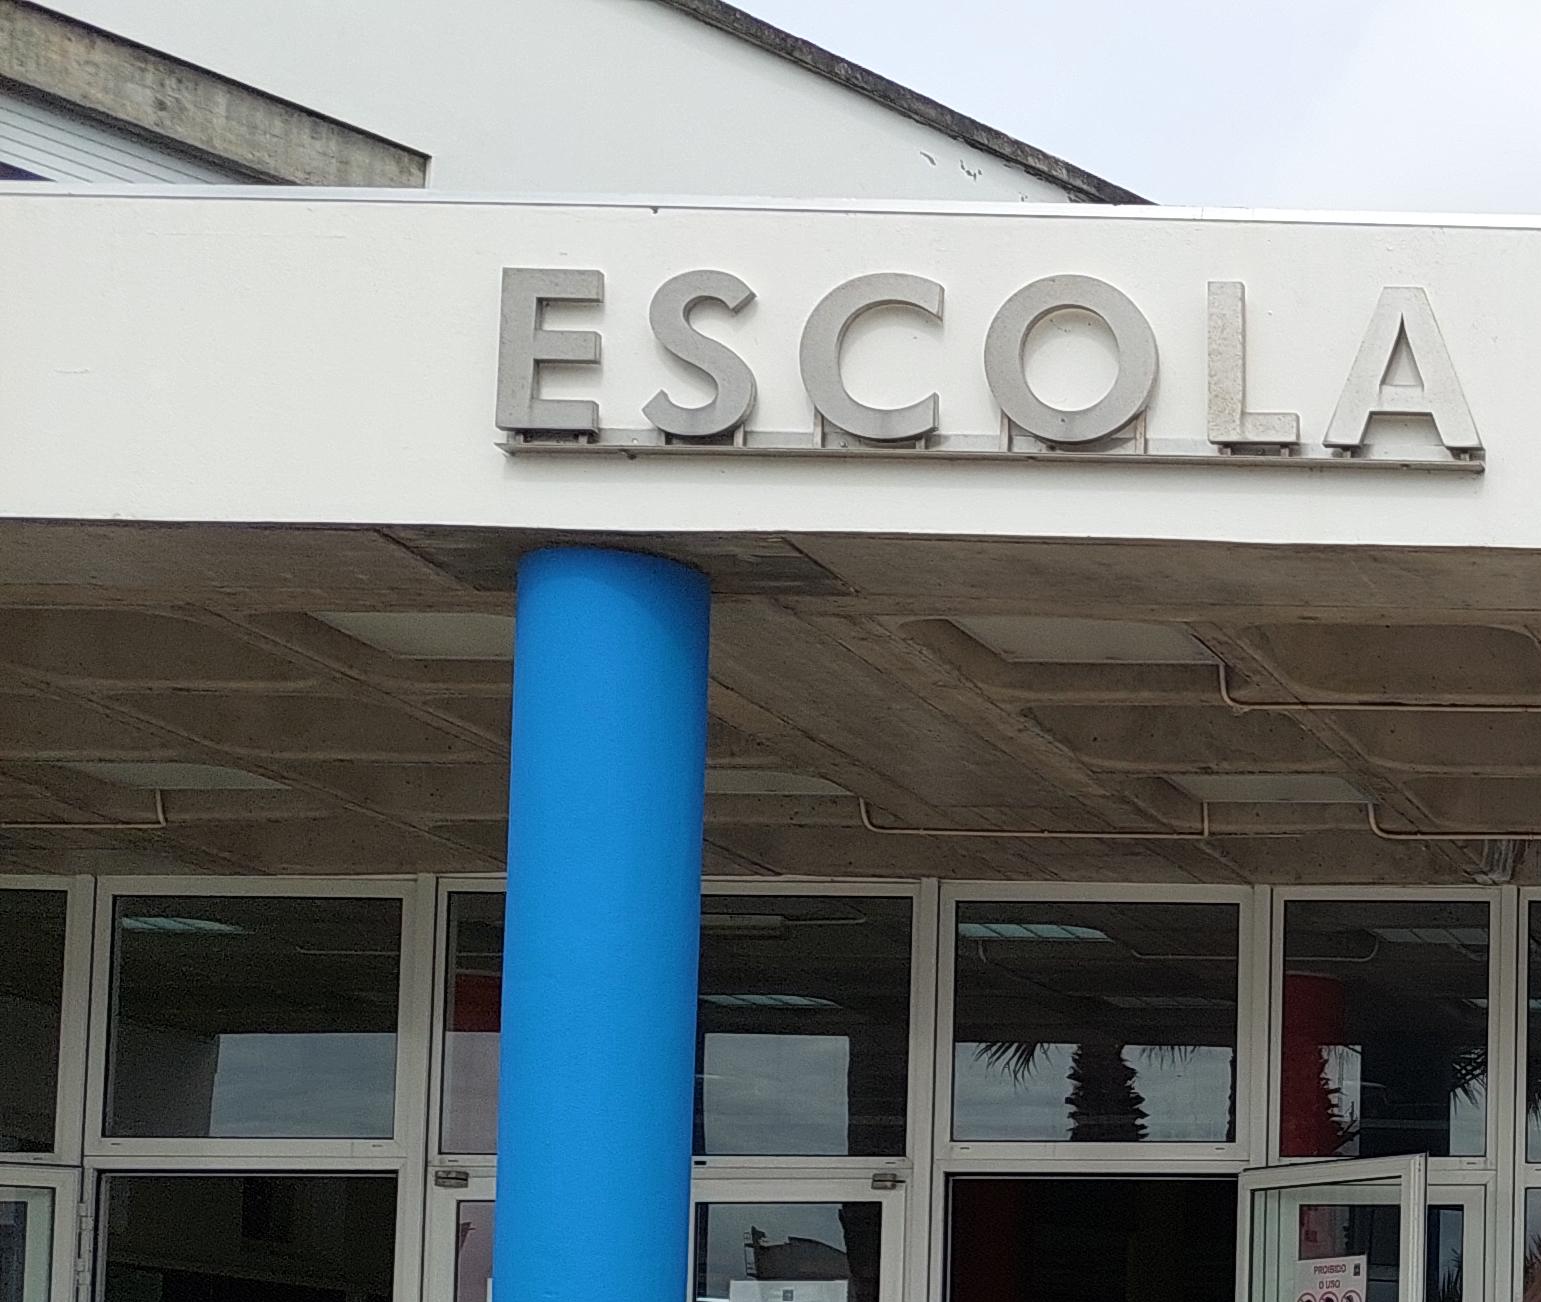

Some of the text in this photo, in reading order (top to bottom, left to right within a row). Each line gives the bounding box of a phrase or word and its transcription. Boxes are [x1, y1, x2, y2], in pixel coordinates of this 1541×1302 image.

[496, 266, 1485, 450] ESCOLA
[1313, 1263, 1347, 1275] PROIBIDO
[1318, 1279, 1341, 1290] O USO
